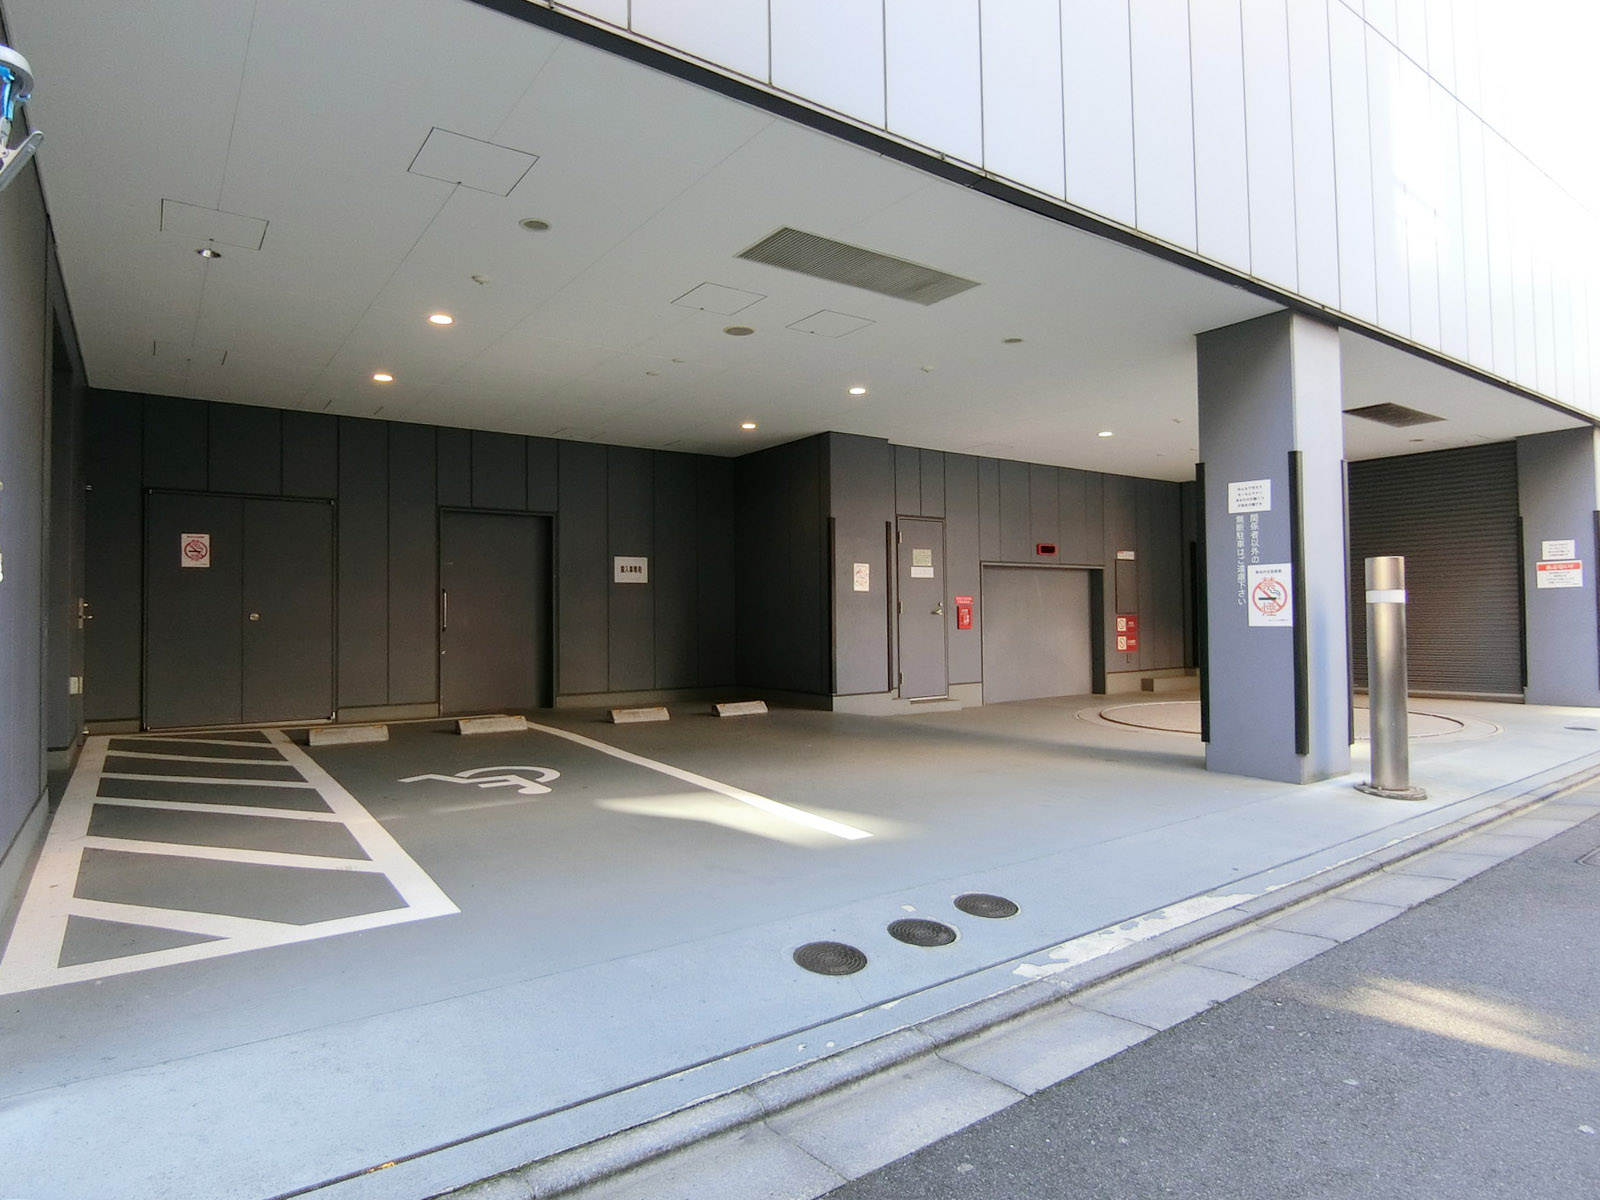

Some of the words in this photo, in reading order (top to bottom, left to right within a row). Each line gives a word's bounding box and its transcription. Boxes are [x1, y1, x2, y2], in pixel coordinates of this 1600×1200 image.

[1250, 513, 1260, 564] 関係者以外の
